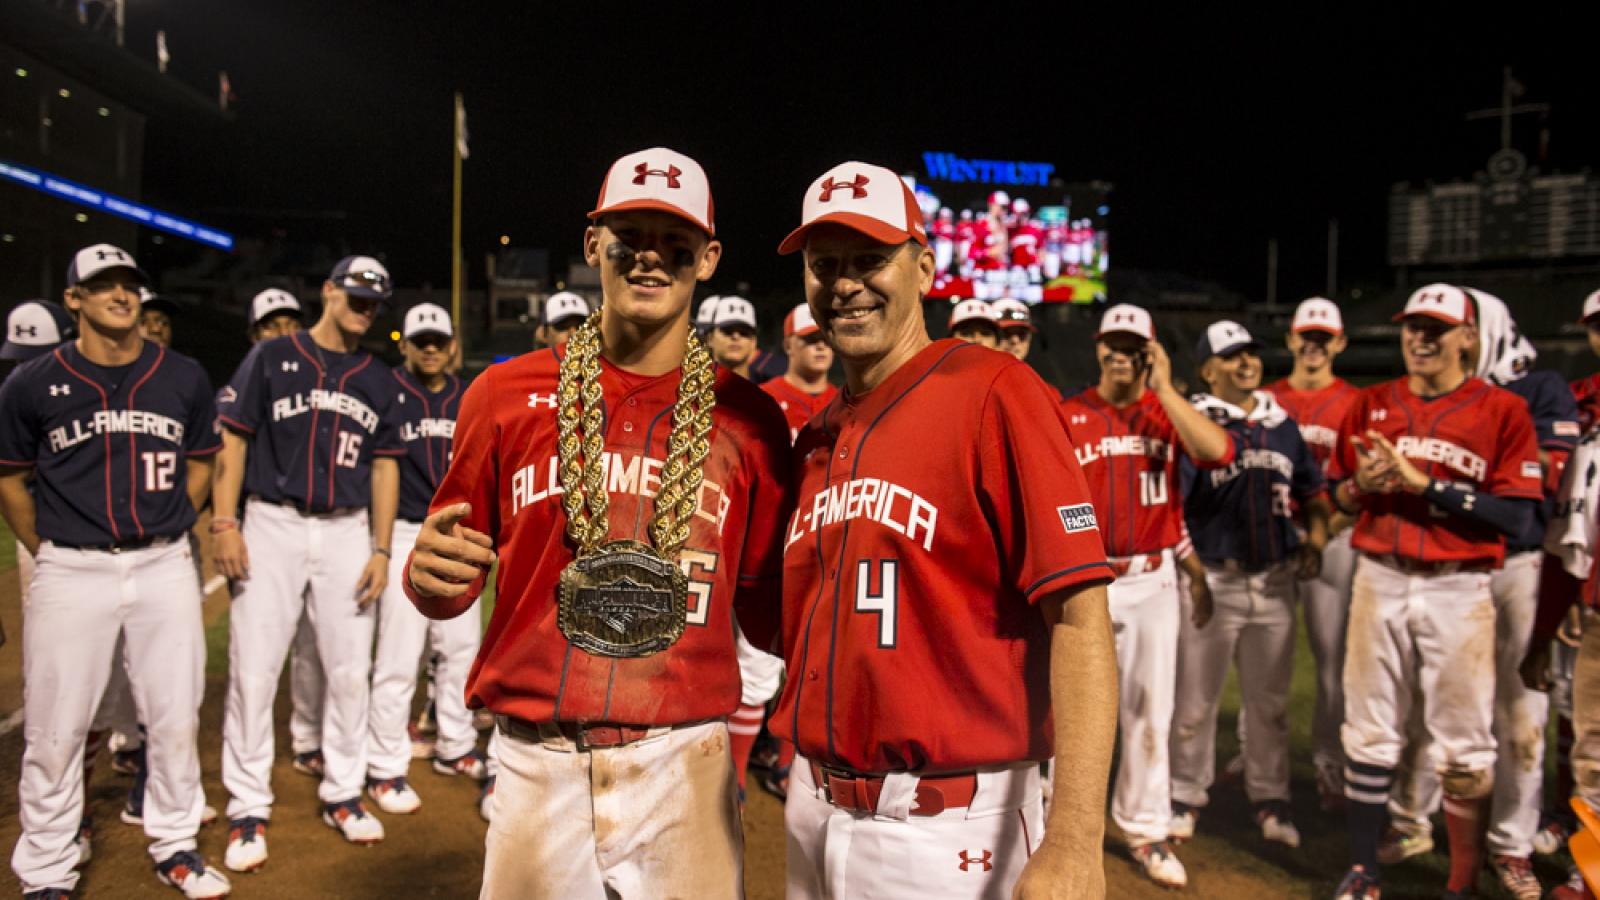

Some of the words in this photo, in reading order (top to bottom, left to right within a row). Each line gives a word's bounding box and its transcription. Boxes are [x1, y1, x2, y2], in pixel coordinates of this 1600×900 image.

[48, 410, 185, 453] ALL-AMERICA
[272, 389, 380, 435] ALL-AMERICA
[141, 451, 177, 491] 12
[335, 431, 364, 469] 15
[1396, 436, 1488, 482] AMERICA
[512, 451, 731, 536] ALLMECA
[1139, 470, 1168, 507] 10
[784, 477, 939, 552] L-AMERICA
[1065, 512, 1097, 530] FACTO
[855, 559, 898, 649] 4
